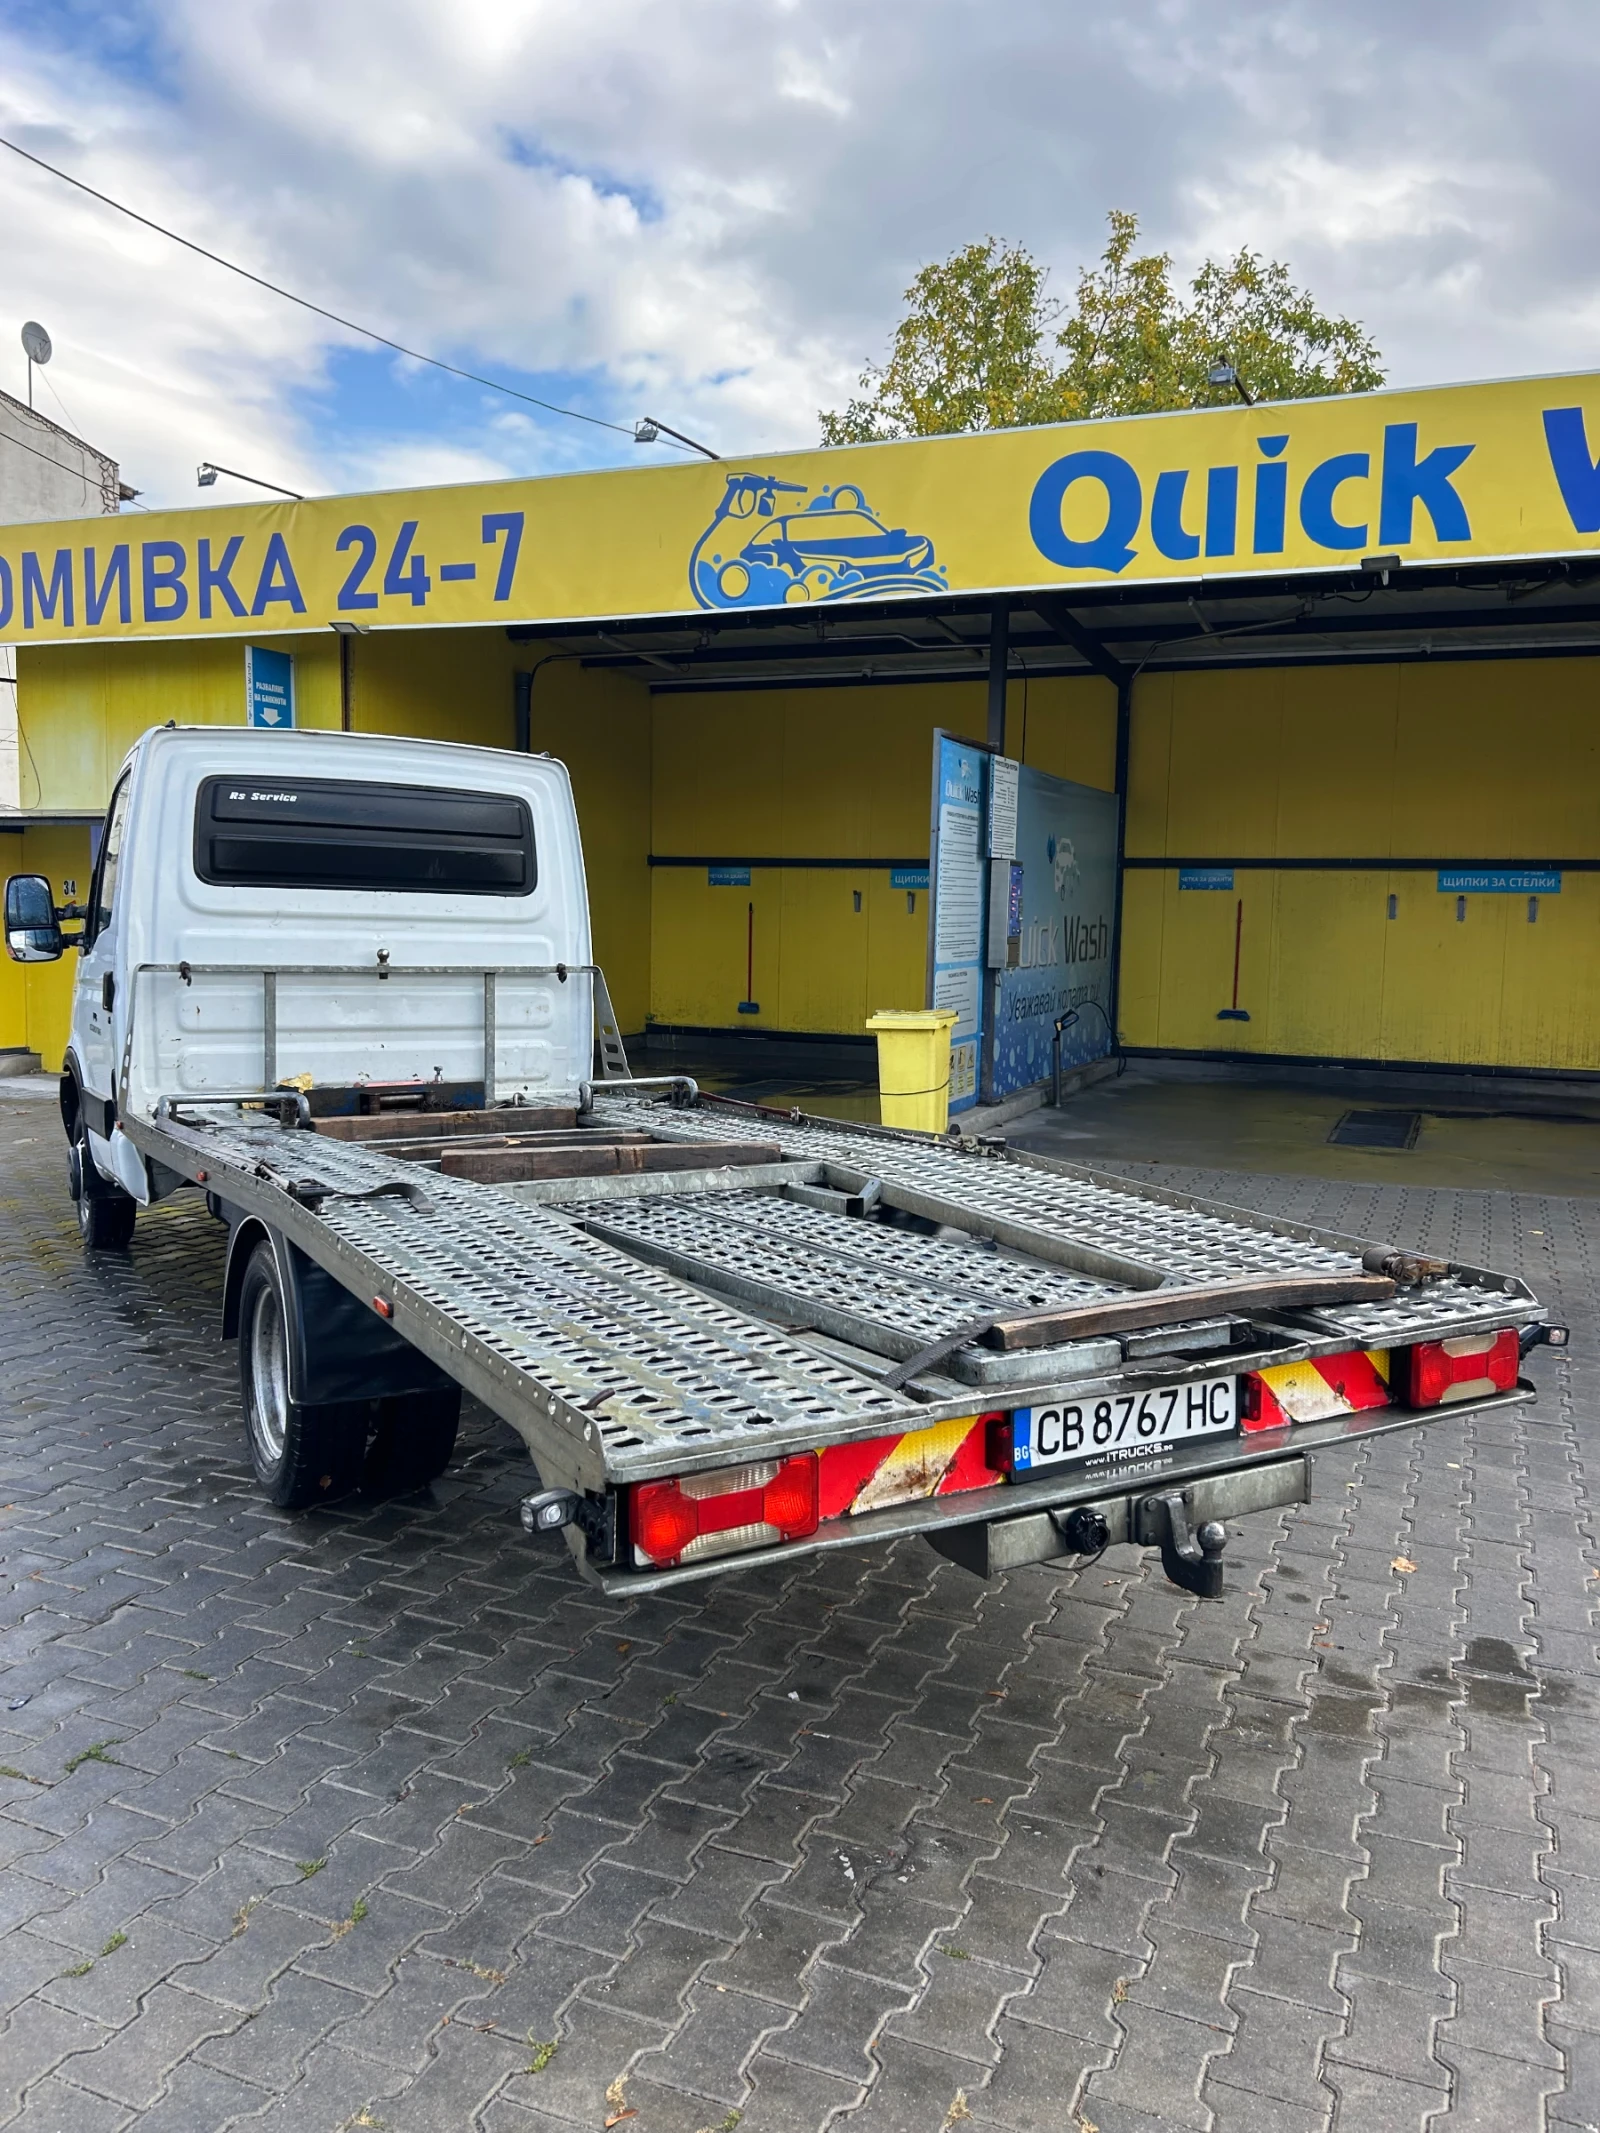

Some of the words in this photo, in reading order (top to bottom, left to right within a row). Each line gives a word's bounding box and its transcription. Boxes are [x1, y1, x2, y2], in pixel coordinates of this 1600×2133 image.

[1029, 422, 1476, 574] Quick
[336, 512, 524, 610] 24-7
[250, 792, 297, 802] Service
[63, 880, 76, 896] 34
[1443, 877, 1489, 888] ЩИПКИ
[1491, 877, 1506, 887] ЗА
[1509, 877, 1555, 888] СТЕЛКИ
[1010, 915, 1059, 972] uick
[1064, 914, 1108, 965] Wash
[1037, 1405, 1084, 1456] CB
[1092, 1388, 1179, 1446] 8767
[1186, 1381, 1230, 1430] HC
[1014, 1445, 1030, 1462] BG
